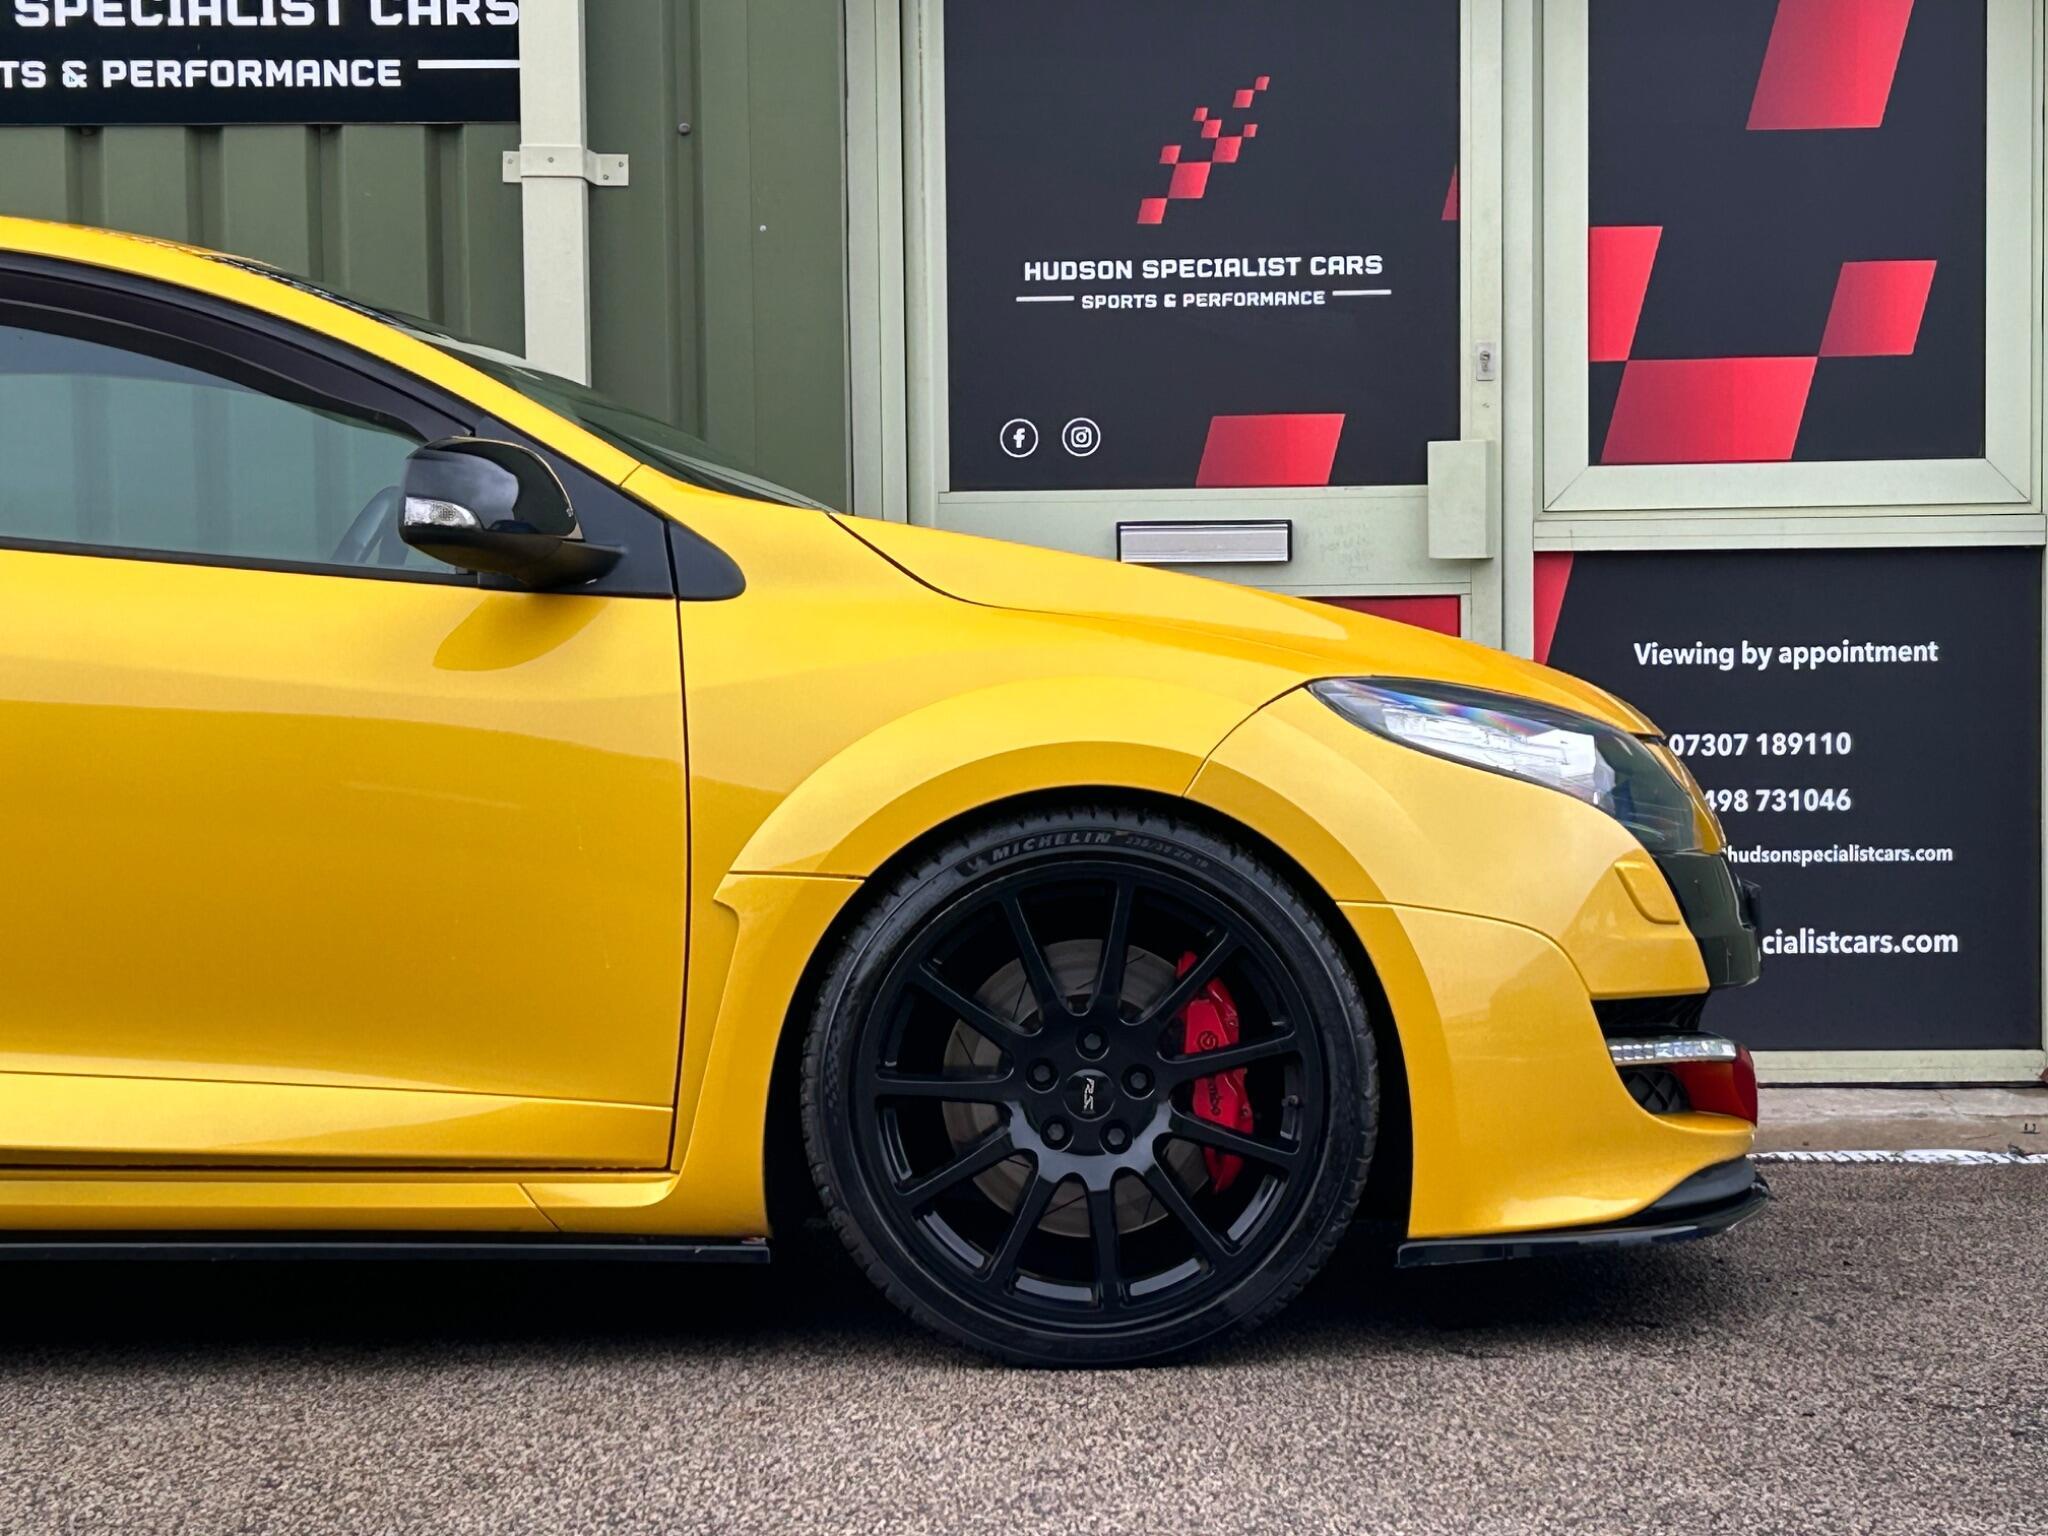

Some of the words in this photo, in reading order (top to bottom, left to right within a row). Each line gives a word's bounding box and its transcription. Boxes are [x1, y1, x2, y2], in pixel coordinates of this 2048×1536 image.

[369, 0, 519, 26] CARS
[61, 60, 88, 88] &
[102, 59, 402, 88] PERFORMANCE
[1024, 259, 1134, 281] HUDSON
[1142, 256, 1302, 279] SPECIALIST
[1309, 254, 1383, 276] CARS
[1081, 293, 1158, 309] SPORTS
[1182, 290, 1326, 308] PERFORMANCE
[1633, 640, 1735, 672] Viewing
[1741, 639, 1774, 671] by
[1778, 638, 1940, 671] appointment
[1668, 733, 1749, 757] 07307
[1755, 731, 1852, 756] 189110
[1704, 788, 1749, 813] 498
[1755, 788, 1852, 812] 731046
[991, 831, 1112, 862] MICHELIN
[1725, 843, 1954, 868] hudsonspecialistcars.com
[1761, 927, 1959, 955] cialistcars.com
